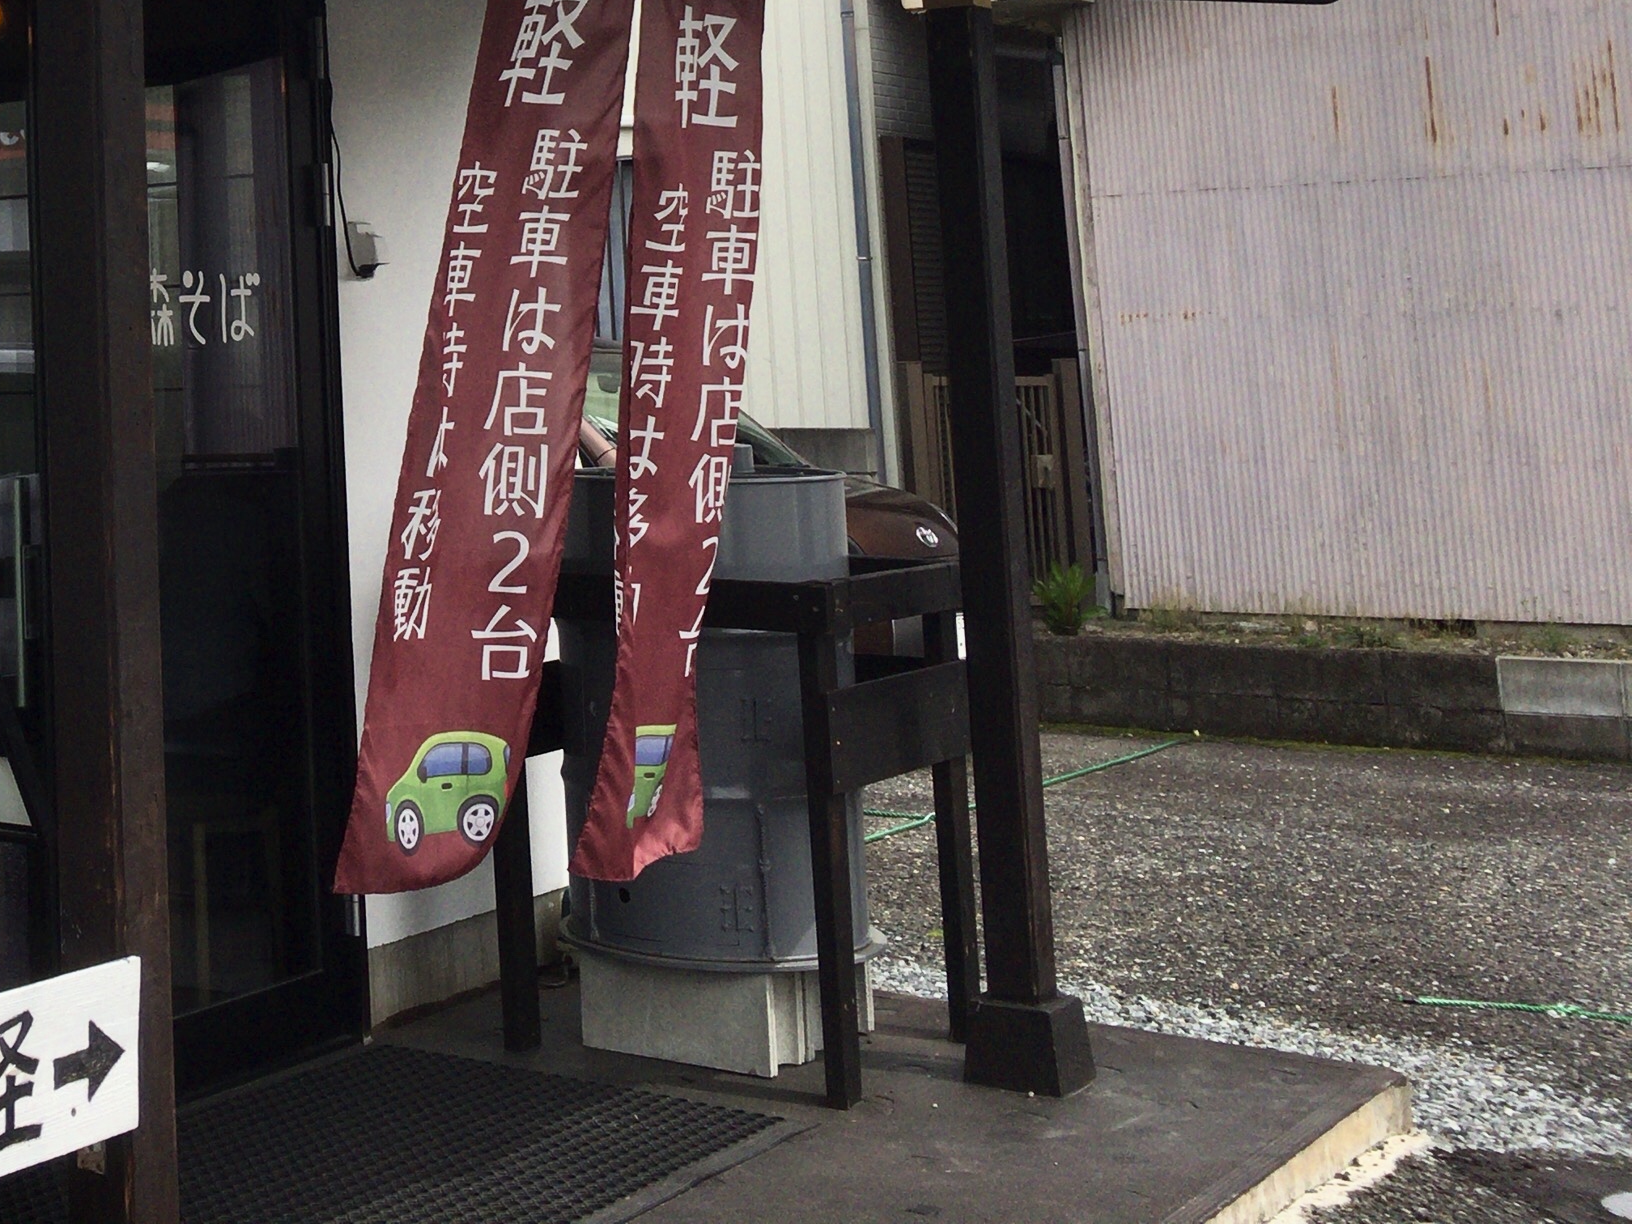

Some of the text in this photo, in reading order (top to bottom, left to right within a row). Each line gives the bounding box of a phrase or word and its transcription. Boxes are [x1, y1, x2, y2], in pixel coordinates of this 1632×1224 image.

[674, 5, 739, 129] 軽
[471, 128, 589, 681] 駐車は店側2台
